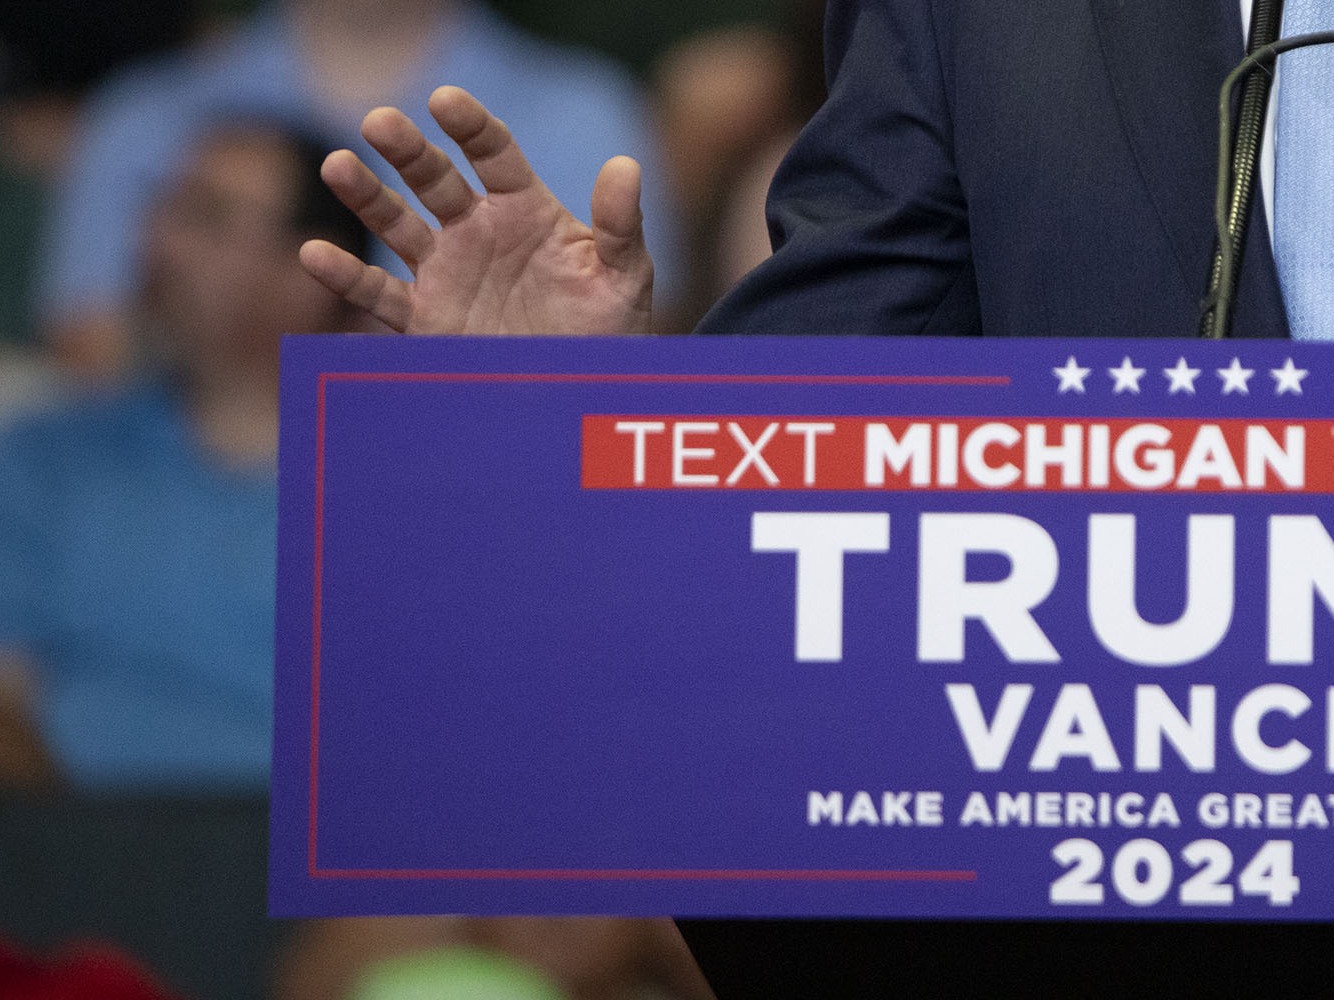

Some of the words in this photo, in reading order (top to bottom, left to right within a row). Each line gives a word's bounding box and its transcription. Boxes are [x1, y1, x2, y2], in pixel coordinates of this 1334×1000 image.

[615, 421, 836, 487] TEXT
[864, 422, 1306, 489] MICHIGAN
[808, 791, 943, 825] MAKE
[960, 791, 1180, 827] AMERICA
[1050, 838, 1300, 906] 2024
